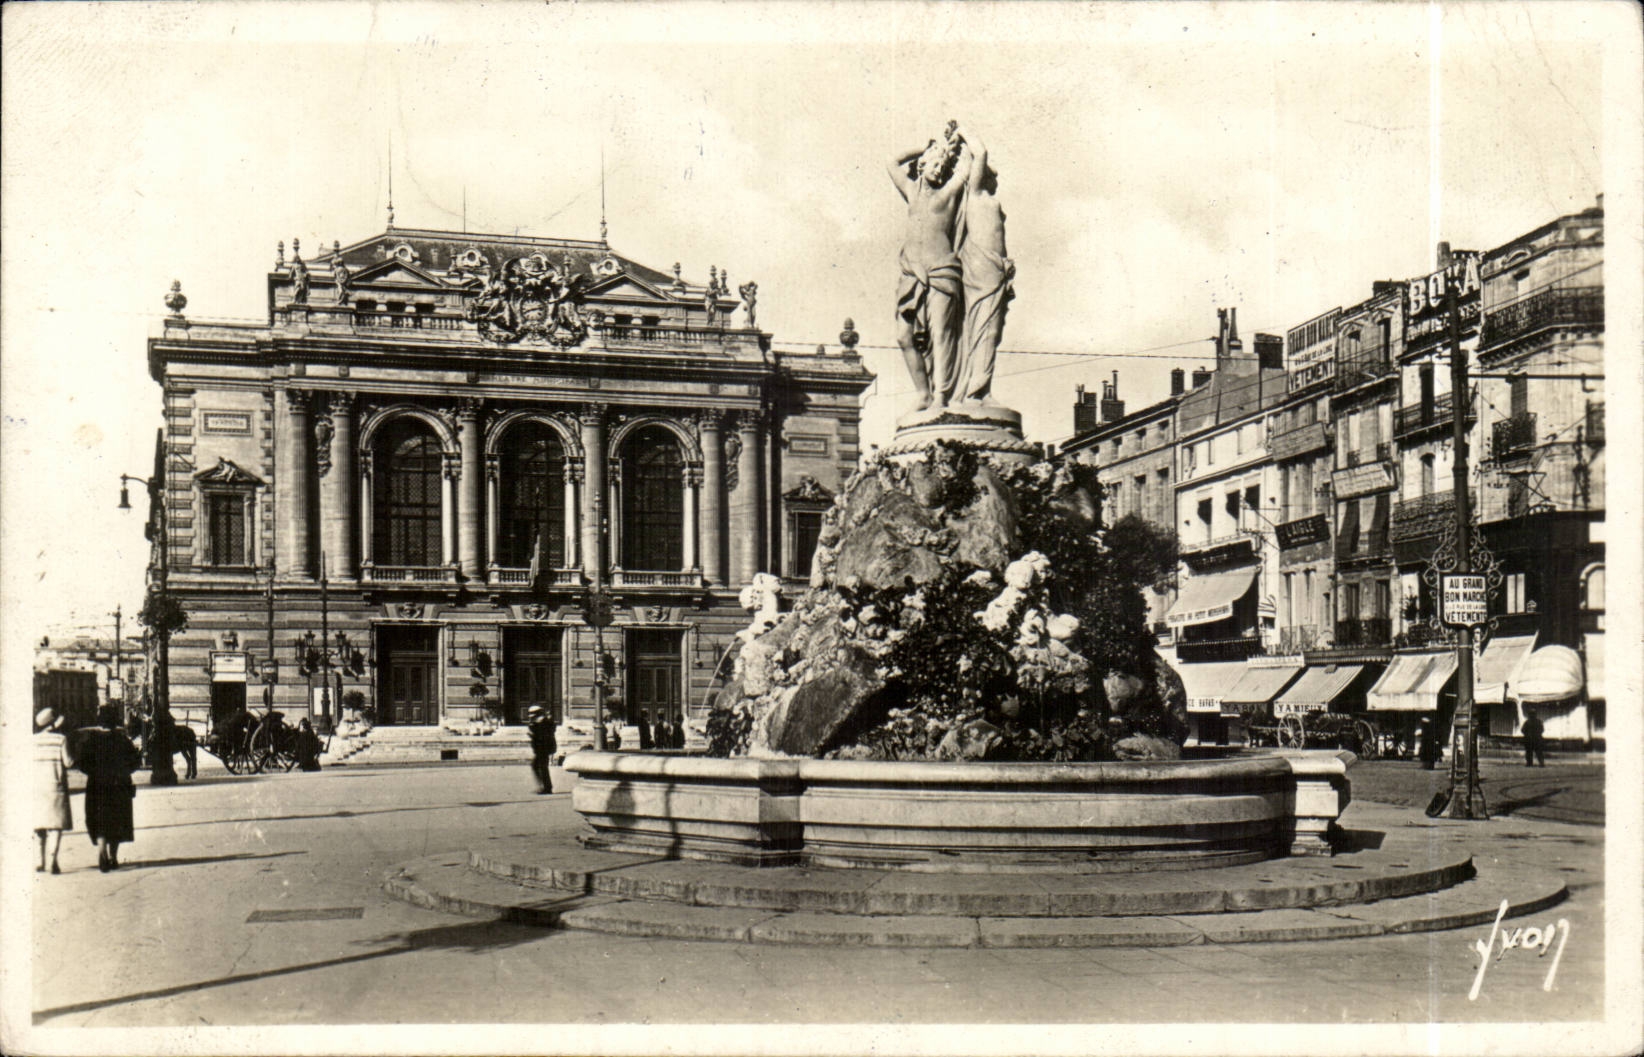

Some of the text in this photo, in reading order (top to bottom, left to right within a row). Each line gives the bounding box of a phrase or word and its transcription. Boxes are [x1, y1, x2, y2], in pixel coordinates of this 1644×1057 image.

[1449, 578, 1482, 588] AU GRAND
[1445, 591, 1460, 602] BON
